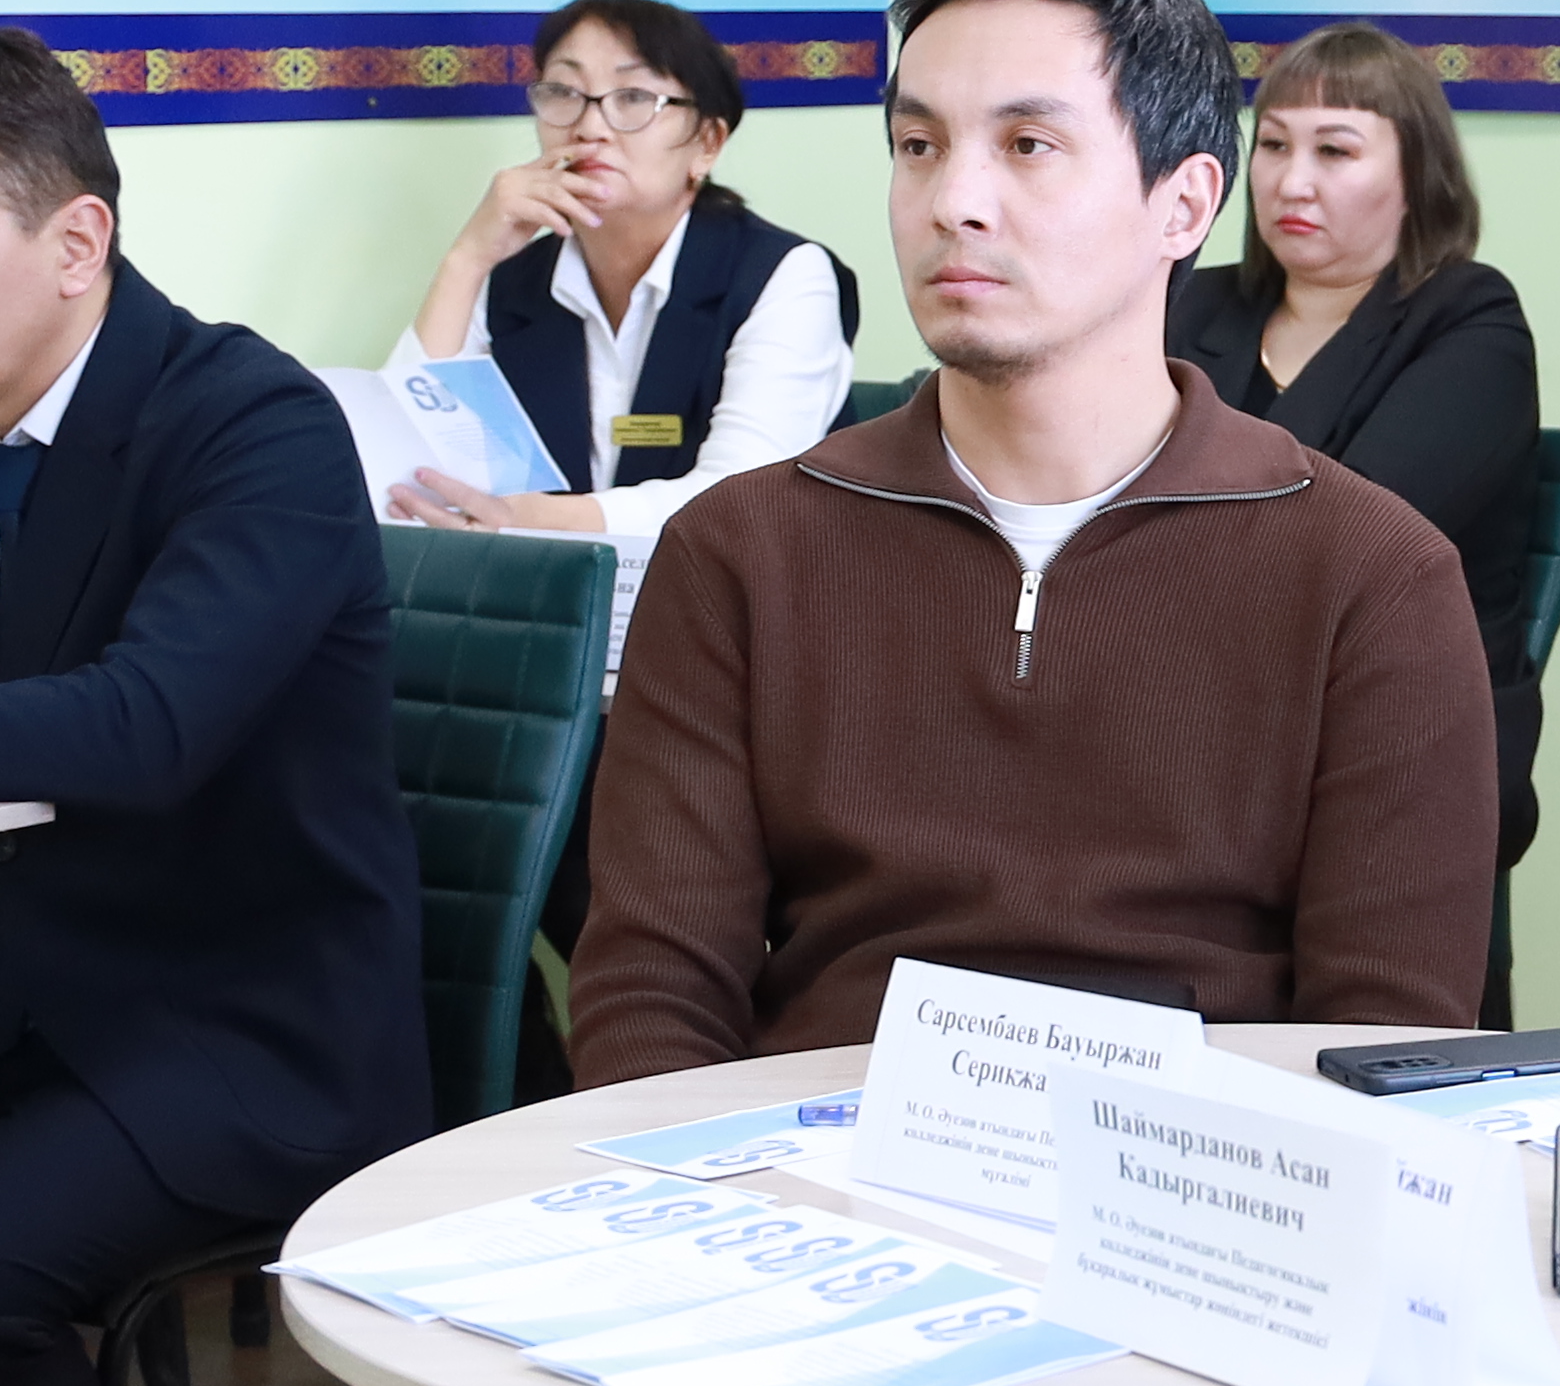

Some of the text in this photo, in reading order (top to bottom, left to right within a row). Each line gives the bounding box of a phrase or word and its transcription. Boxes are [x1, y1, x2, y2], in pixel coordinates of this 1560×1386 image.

[917, 997, 1162, 1071] Сарсембаев Бауыржан
[951, 1049, 1049, 1093] Серикжа
[1092, 1099, 1263, 1171] Шаймарданов
[1269, 1149, 1330, 1190] Асан
[1118, 1151, 1306, 1232] Кадыргалиевич
